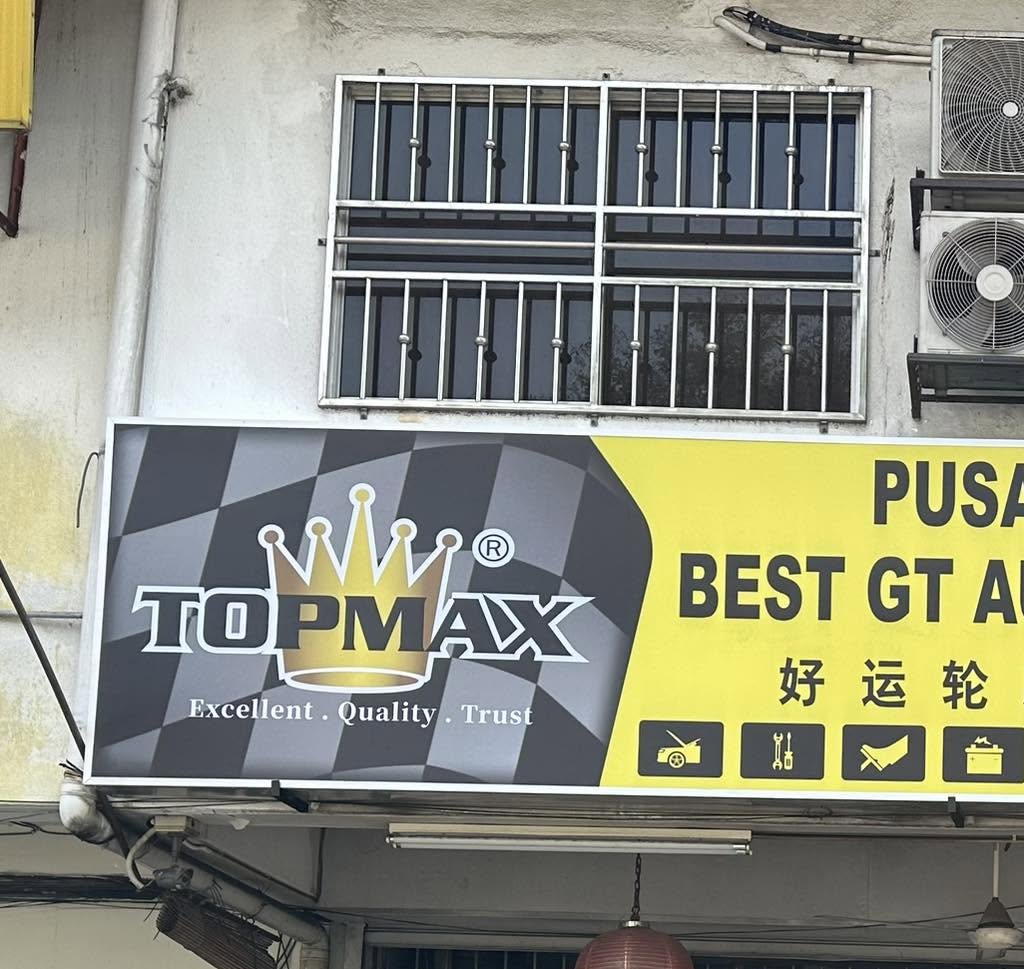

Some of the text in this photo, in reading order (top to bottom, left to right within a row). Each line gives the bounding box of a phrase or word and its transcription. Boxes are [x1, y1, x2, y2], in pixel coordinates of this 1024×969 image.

[679, 552, 846, 622] BEST
[867, 556, 954, 623] GT
[131, 584, 595, 663] TOPMAX
[188, 697, 534, 728] Excellent Quality Trust
